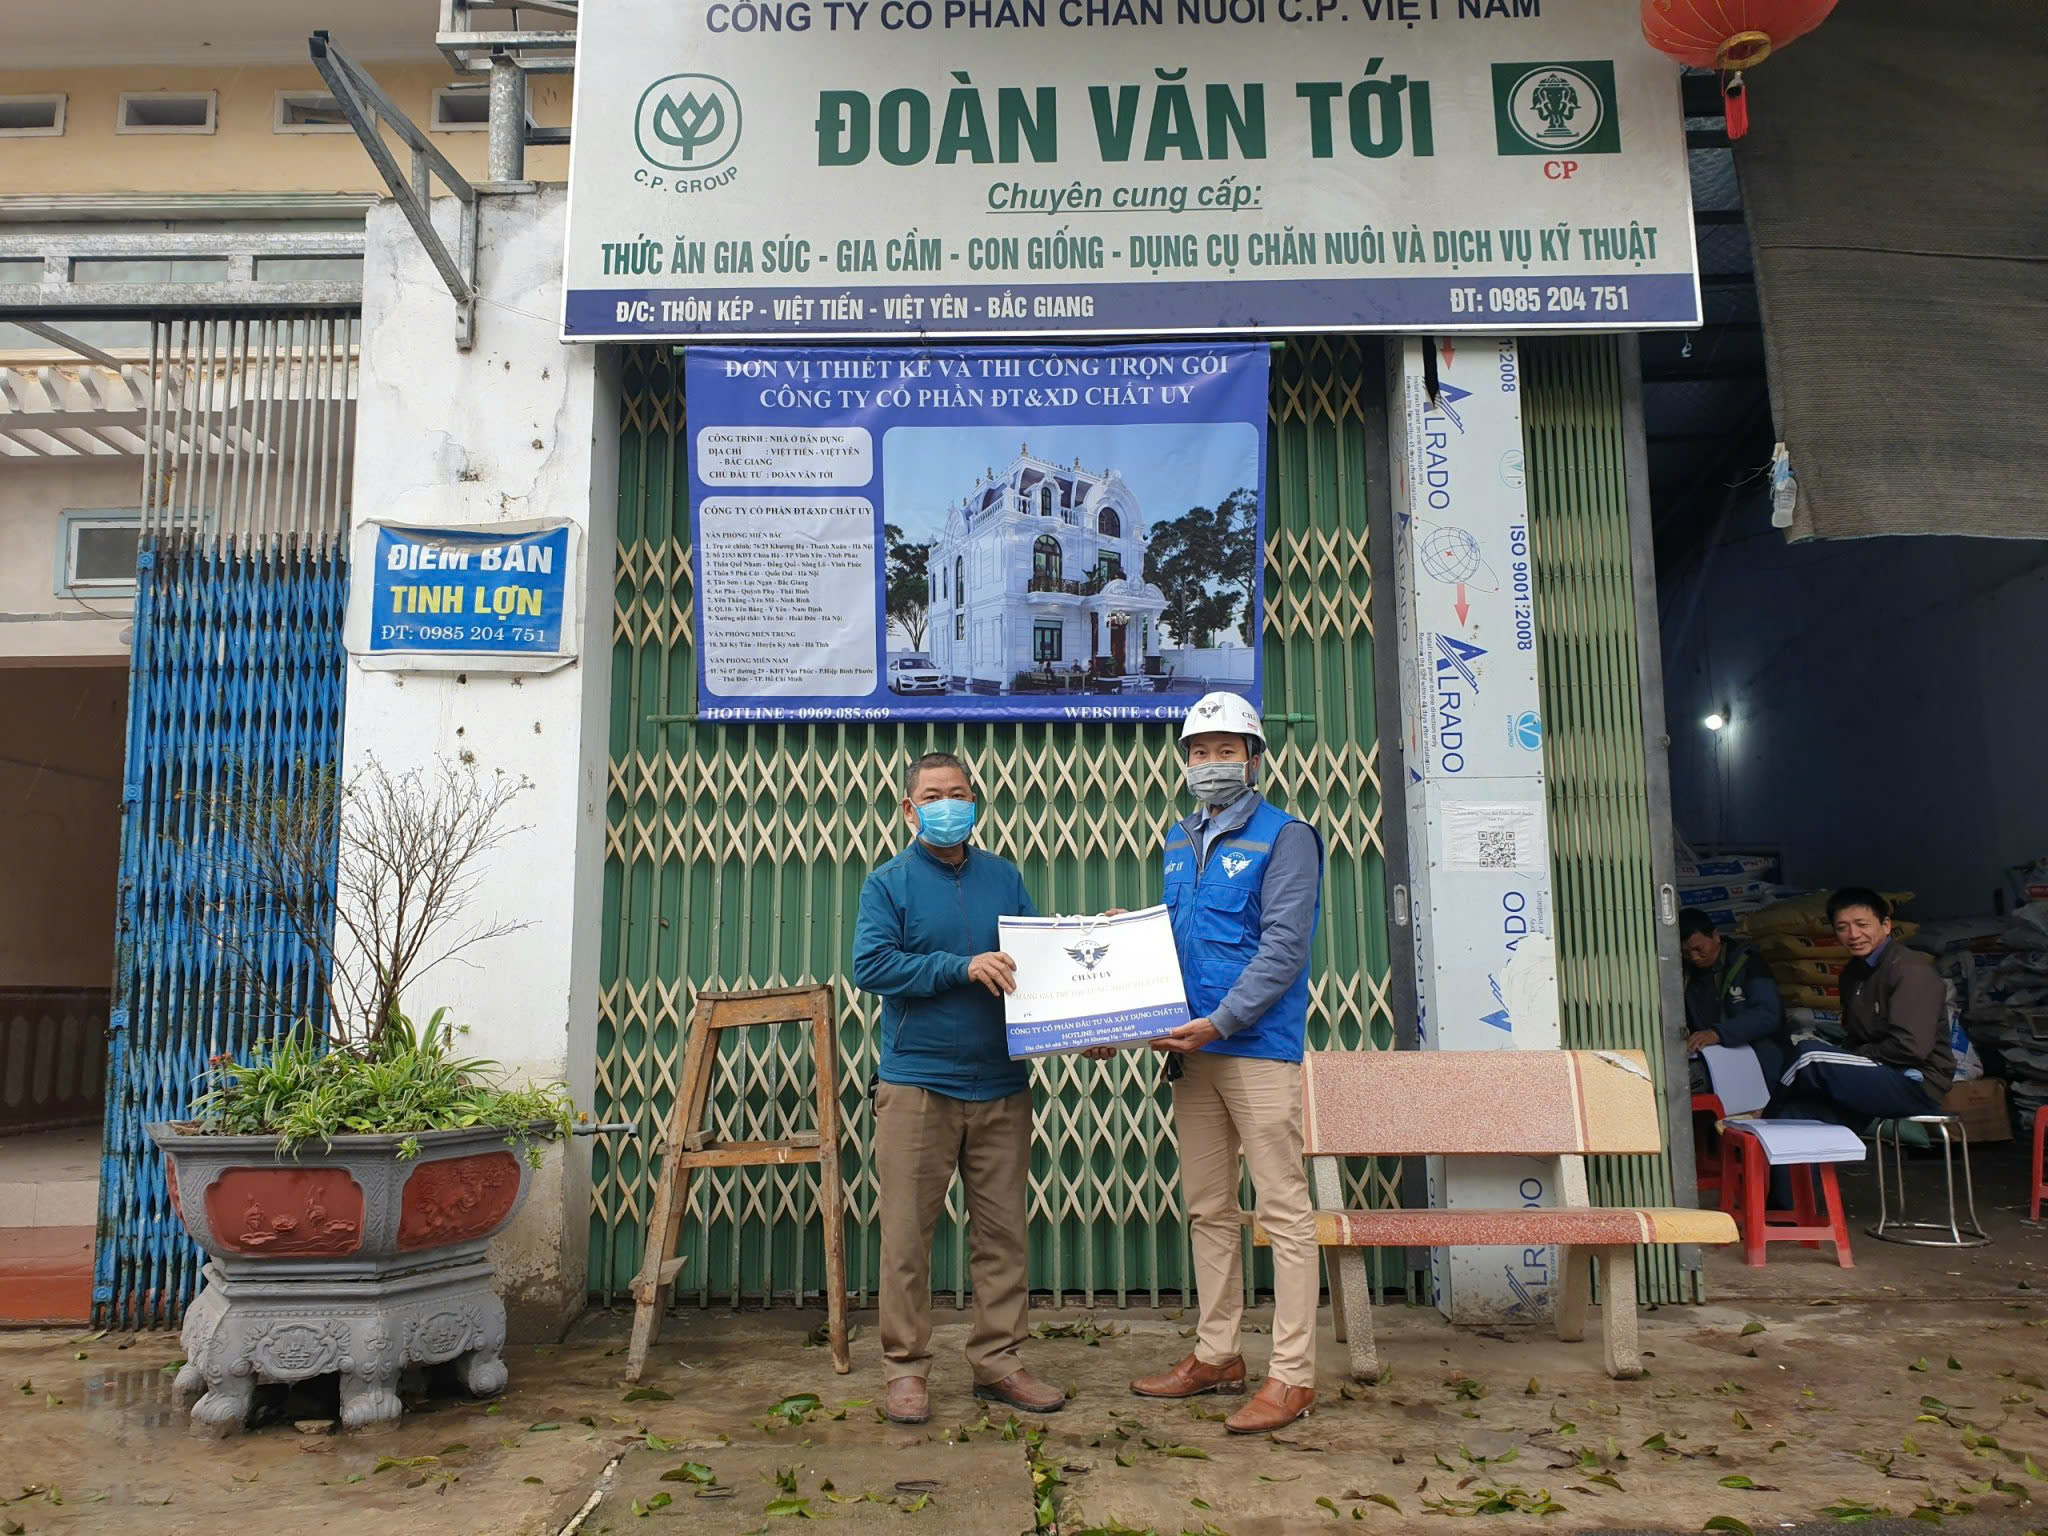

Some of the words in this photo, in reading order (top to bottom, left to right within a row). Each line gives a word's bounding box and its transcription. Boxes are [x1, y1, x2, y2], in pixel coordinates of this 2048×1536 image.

[823, 2, 869, 31] TY
[815, 71, 1057, 167] ĐOÀN
[1087, 67, 1267, 164] VĂN
[1295, 57, 1434, 159] TỚI
[633, 168, 668, 193] C.P.
[675, 165, 740, 194] GROUP
[1543, 160, 1578, 181] CP
[987, 182, 1103, 216] Chuyên
[1112, 185, 1187, 214] cung
[1196, 175, 1262, 212] cấp:
[601, 233, 663, 275] THỨC
[670, 235, 705, 274] ĂN
[714, 240, 754, 274] GIA
[761, 234, 811, 273] SÚC
[836, 239, 877, 272] GIA
[886, 227, 942, 271] CẦM
[968, 237, 1019, 271] CON
[1027, 225, 1104, 270] GIỐNG
[1130, 233, 1198, 275] DỤNG
[1207, 233, 1239, 274] CỤ
[1248, 225, 1317, 266] CHĂN
[1325, 224, 1385, 265] NUÔI
[1392, 224, 1426, 263] VÀ
[1433, 230, 1492, 270] DỊCH
[1500, 229, 1532, 270] VỤ
[1540, 222, 1571, 262] KỸ
[1579, 220, 1658, 267] THUẬT
[616, 300, 655, 323] Đ/C:
[661, 296, 712, 322] THÔN
[718, 295, 754, 321] KÉP
[773, 295, 815, 325] VIỆT
[819, 291, 863, 321] TIẾN
[883, 293, 924, 325] VIỆT
[930, 293, 968, 319] YÊN
[988, 289, 1027, 318] BẮC
[1033, 295, 1094, 318] GIANG
[1450, 287, 1483, 313] ĐT:
[1489, 287, 1541, 312] 0985
[1547, 286, 1587, 311] 204
[1591, 286, 1629, 311] 751
[725, 359, 778, 378] ĐƠN
[784, 360, 810, 384] VỊ
[817, 356, 893, 379] THIẾT
[899, 354, 931, 378] KẾ
[938, 355, 972, 378] VÀ
[978, 359, 1020, 377] THI
[1028, 353, 1099, 377] CÔNG
[1106, 356, 1174, 380] TRỌN
[1182, 351, 1229, 374] GÓI
[759, 384, 832, 408] CÔNG
[837, 390, 870, 408] TY
[876, 383, 911, 408] CỔ
[918, 383, 983, 408] PHẦN
[990, 387, 1078, 407] ĐT&XD
[1085, 381, 1153, 406] CHẤT
[1160, 385, 1195, 404] UY
[708, 433, 733, 443] CÔNG
[744, 458, 773, 466] GIANG
[704, 504, 732, 516] CÔNG
[735, 507, 748, 516] TY
[858, 506, 872, 516] UY
[1509, 525, 1527, 557] ISO
[390, 585, 465, 614] TINH
[474, 584, 543, 621] LỢN
[1511, 561, 1533, 651] 9001:2008
[381, 625, 413, 640] ĐT:
[419, 626, 465, 640] 0985
[470, 626, 505, 641] 204
[511, 627, 546, 643] 751
[707, 707, 785, 720] HOTLINE
[799, 707, 890, 719] 0969.085.669
[1063, 706, 1141, 719] WEBSITE
[1435, 632, 1488, 773] ALRADO
[1429, 706, 1437, 733] direction
[1010, 1026, 1031, 1035] CÔNG
[1031, 1026, 1042, 1034] TY
[1103, 1016, 1113, 1024] VÀ
[1114, 1014, 1129, 1022] XÂY
[1062, 1029, 1095, 1040] HOTLINE:
